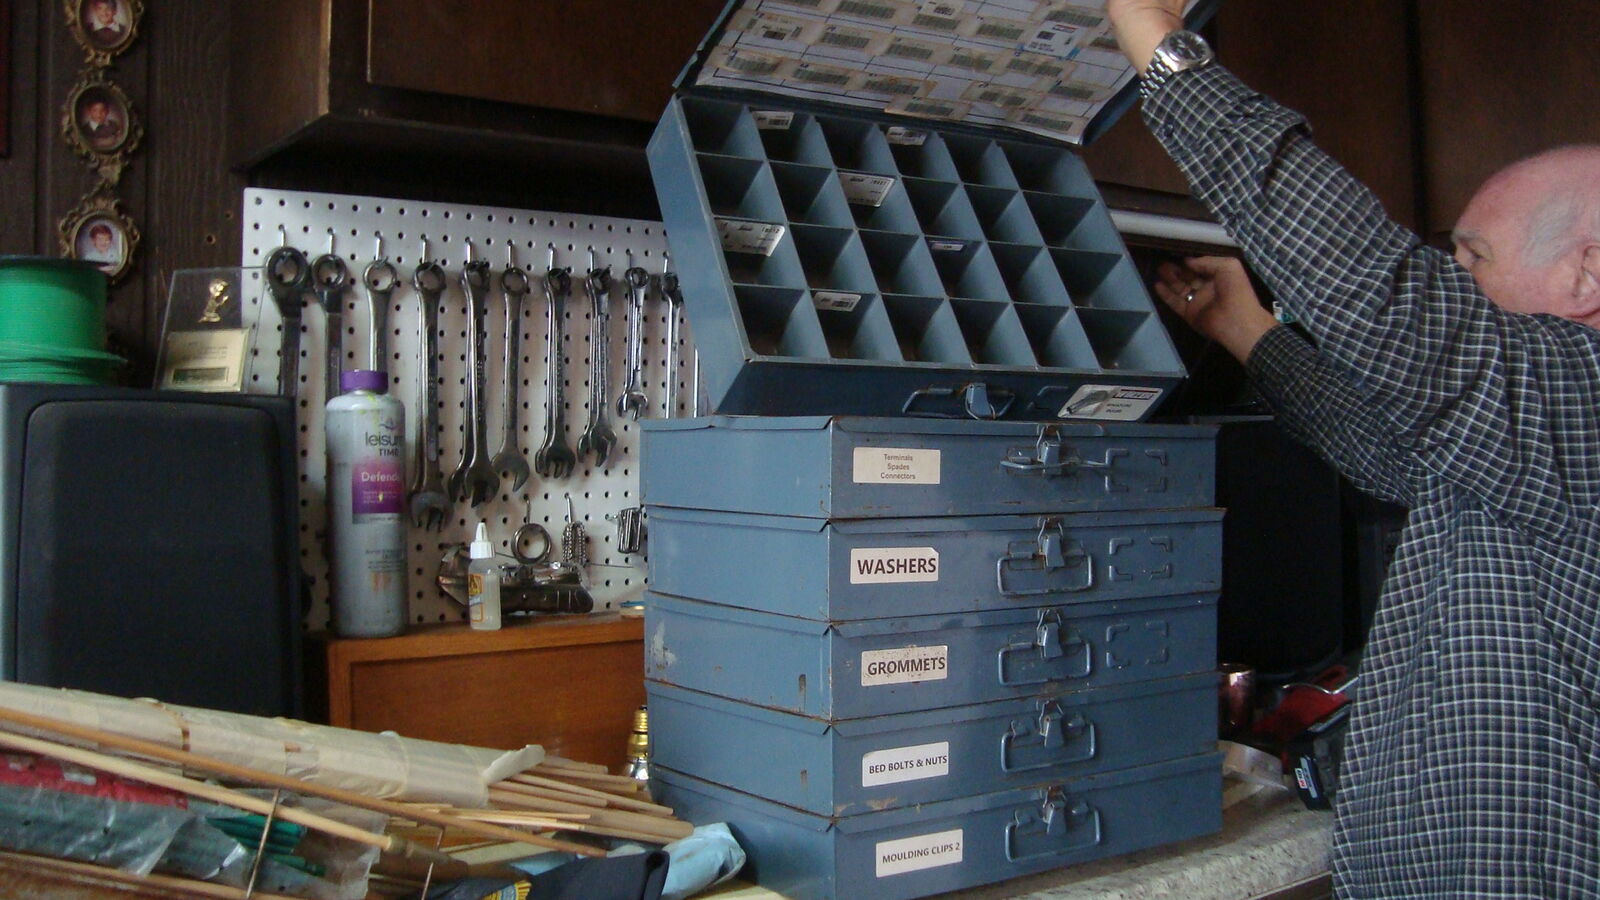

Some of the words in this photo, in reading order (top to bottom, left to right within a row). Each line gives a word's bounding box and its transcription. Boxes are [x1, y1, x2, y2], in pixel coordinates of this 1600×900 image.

[884, 453, 913, 461] Terminals
[887, 462, 910, 471] Spades
[880, 472, 916, 480] Connectors
[857, 558, 936, 575] WASHERS
[867, 656, 946, 676] GROMMETS
[869, 763, 886, 774] BED
[888, 759, 914, 771] BOLTS
[916, 758, 924, 768] &
[925, 755, 947, 766] NUTS
[882, 847, 930, 864] MOULDING
[931, 843, 954, 856] CLIPS
[955, 842, 960, 851] 2
